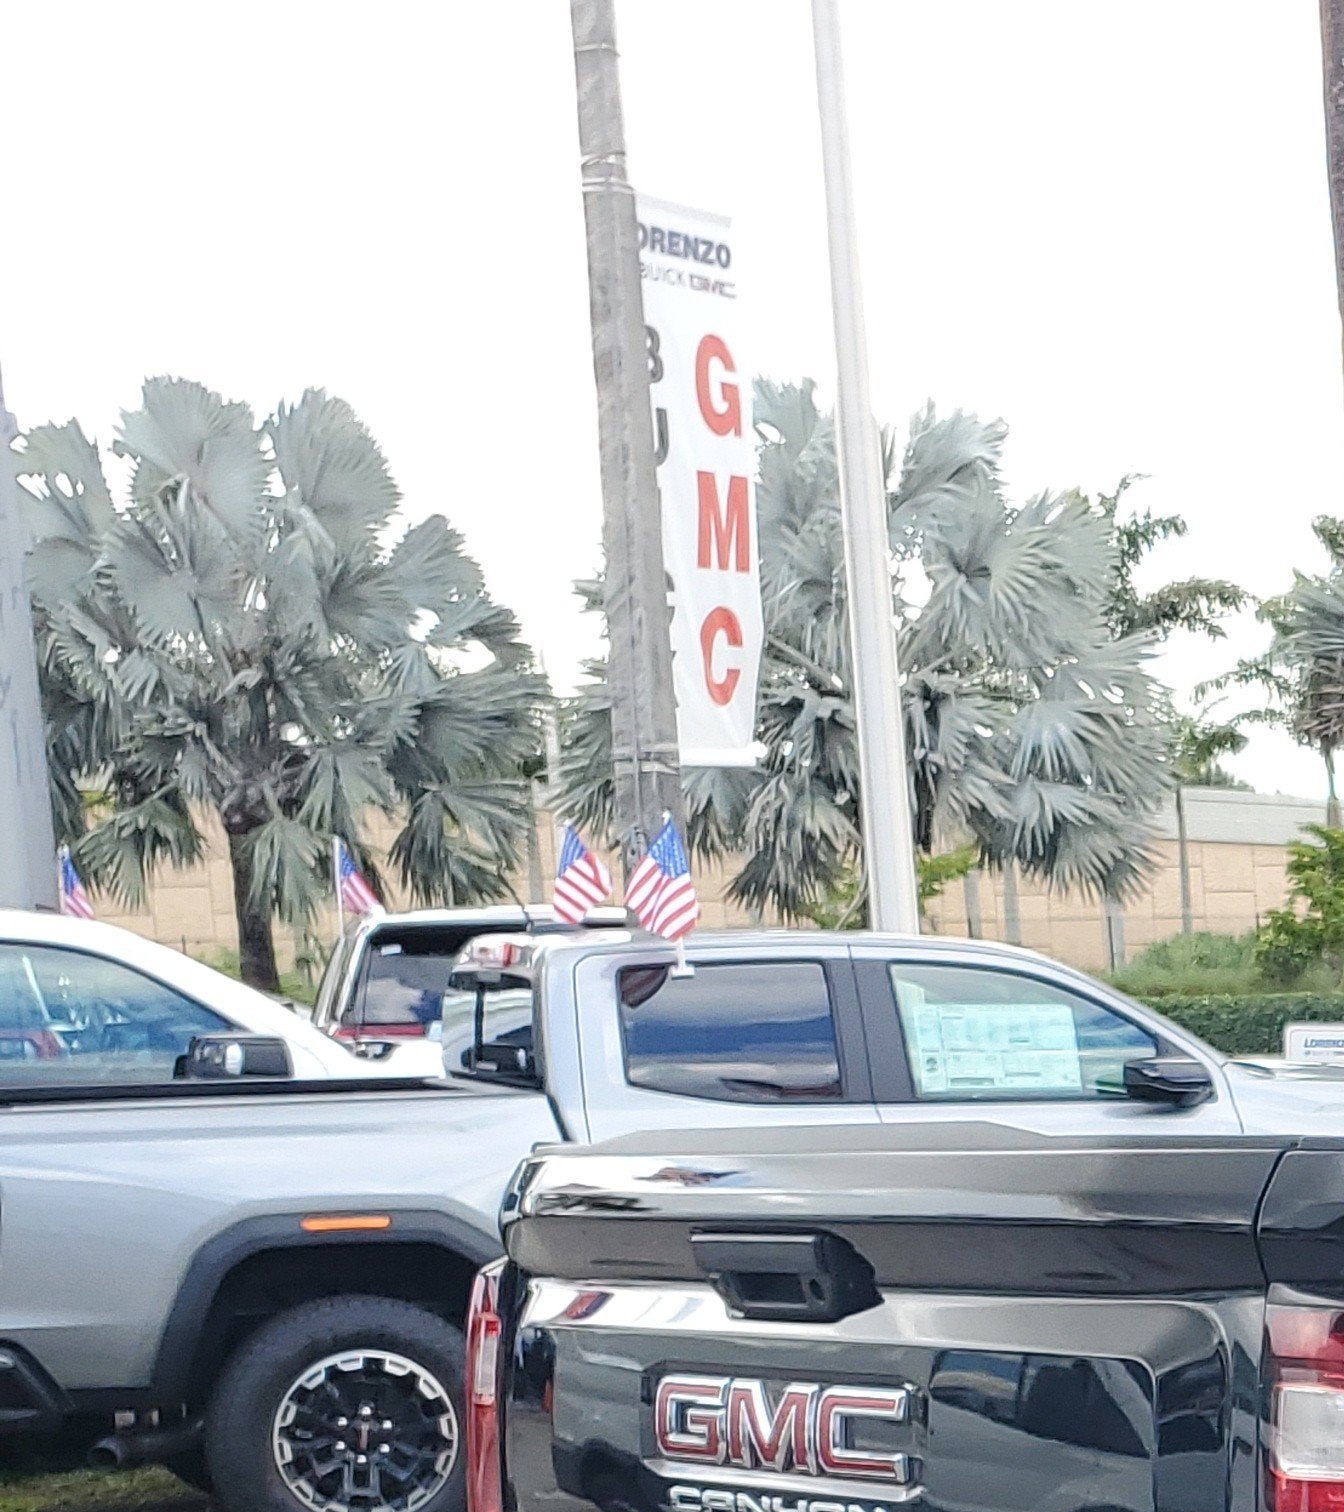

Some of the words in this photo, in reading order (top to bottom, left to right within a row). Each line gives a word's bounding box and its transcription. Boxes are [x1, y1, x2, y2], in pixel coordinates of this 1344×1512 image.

[637, 222, 731, 268] ORENZO
[689, 274, 738, 300] GMC
[694, 333, 751, 706] GMC
[655, 1374, 909, 1484] GMC
